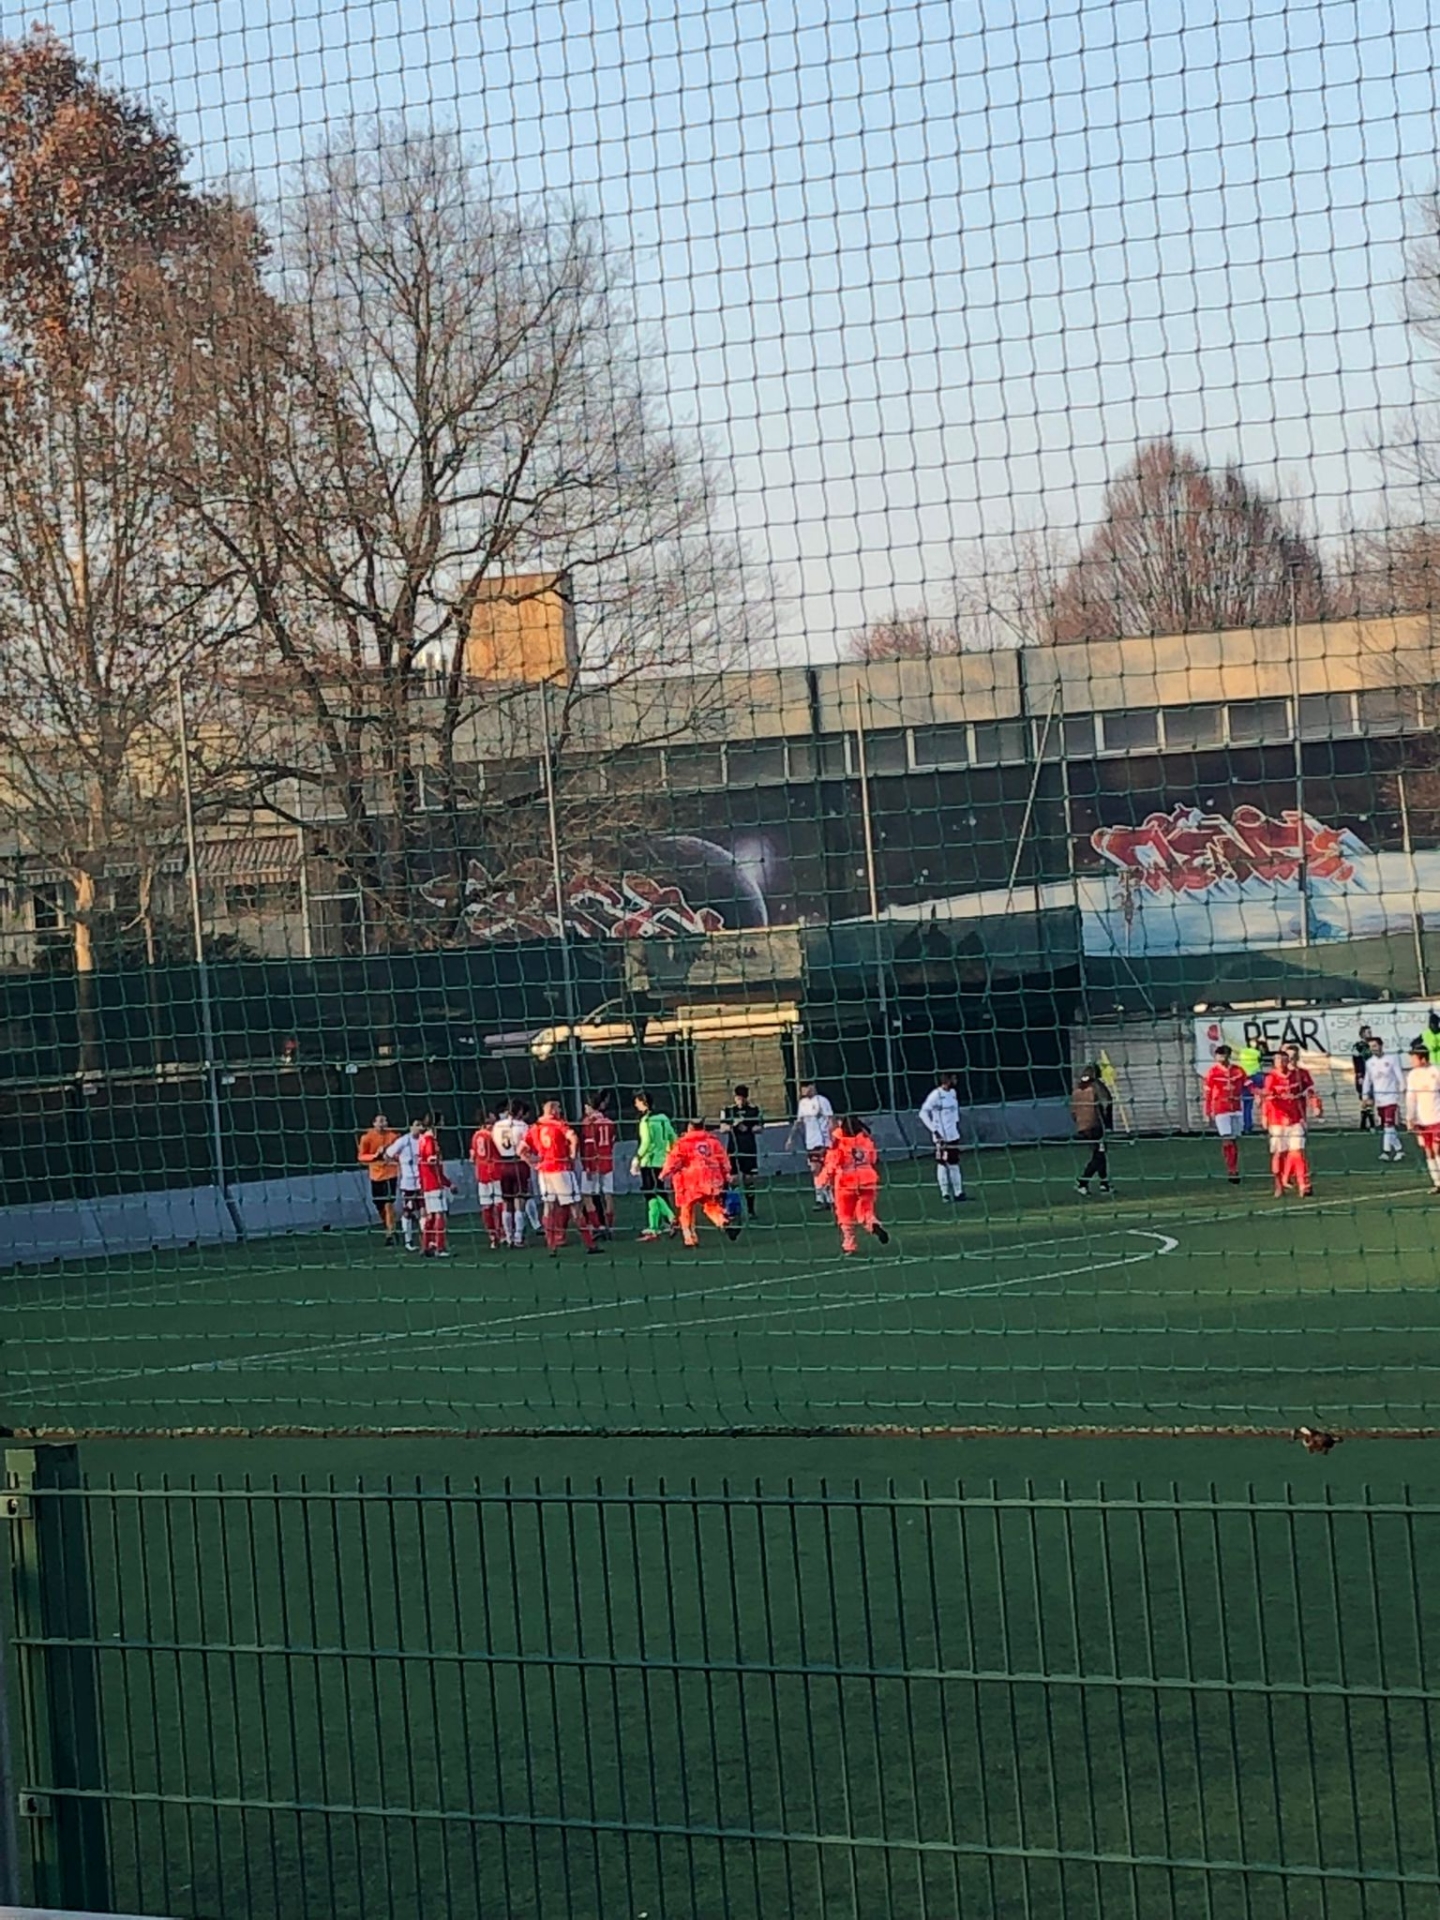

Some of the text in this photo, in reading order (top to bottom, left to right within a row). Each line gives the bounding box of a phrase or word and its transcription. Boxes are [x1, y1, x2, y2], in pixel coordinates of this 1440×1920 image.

[501, 1129, 512, 1150] 5
[540, 1126, 551, 1148] 6
[598, 1125, 610, 1147] 11
